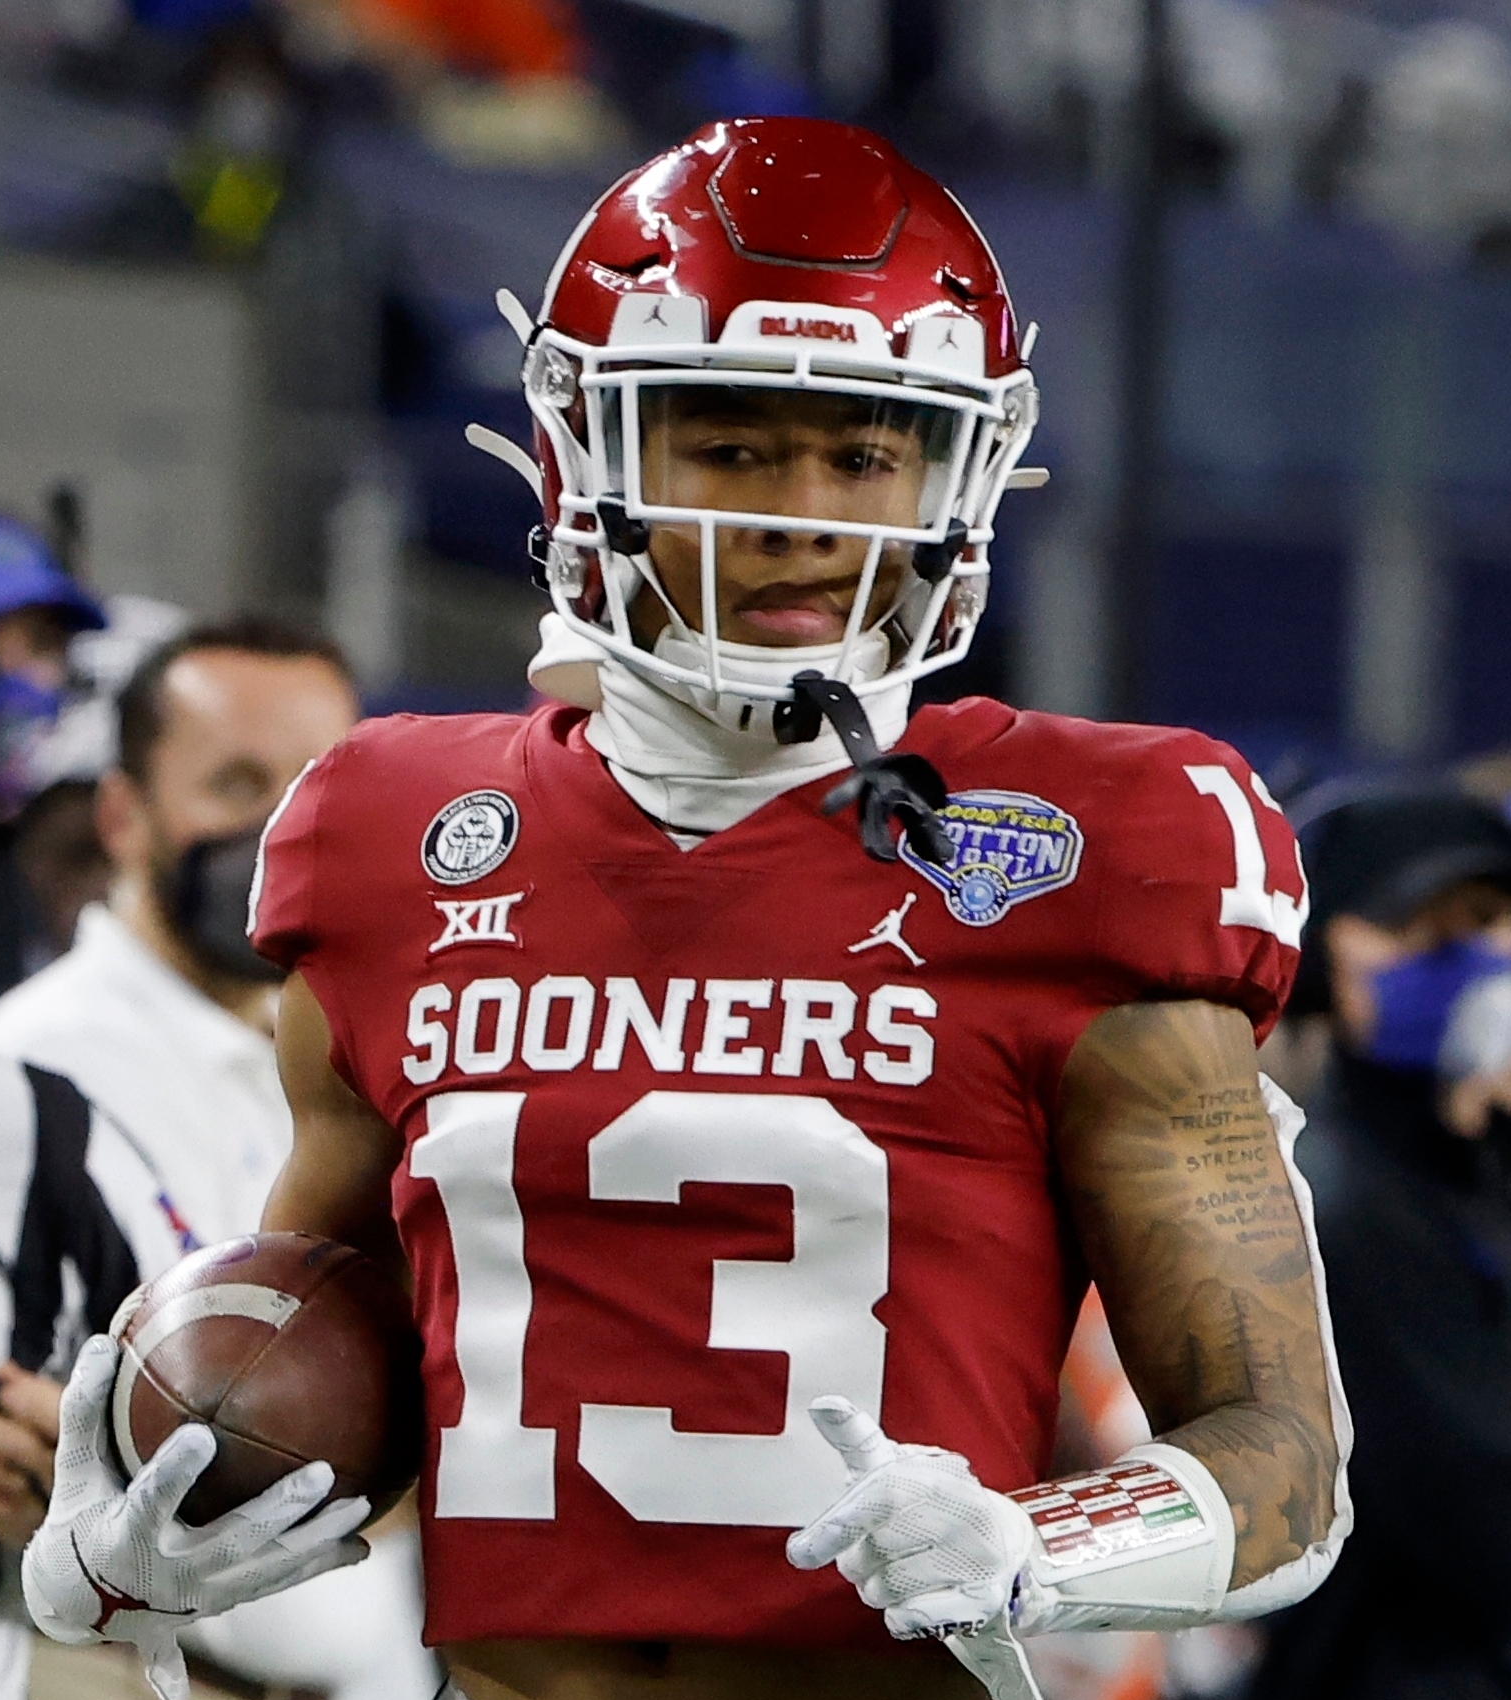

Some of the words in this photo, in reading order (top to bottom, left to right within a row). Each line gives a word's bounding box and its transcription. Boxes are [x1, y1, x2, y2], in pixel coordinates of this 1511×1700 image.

[940, 820, 1066, 875] OTTON
[428, 892, 527, 953] XII
[402, 973, 938, 1087] SOONERS
[409, 1090, 889, 1528] 13
